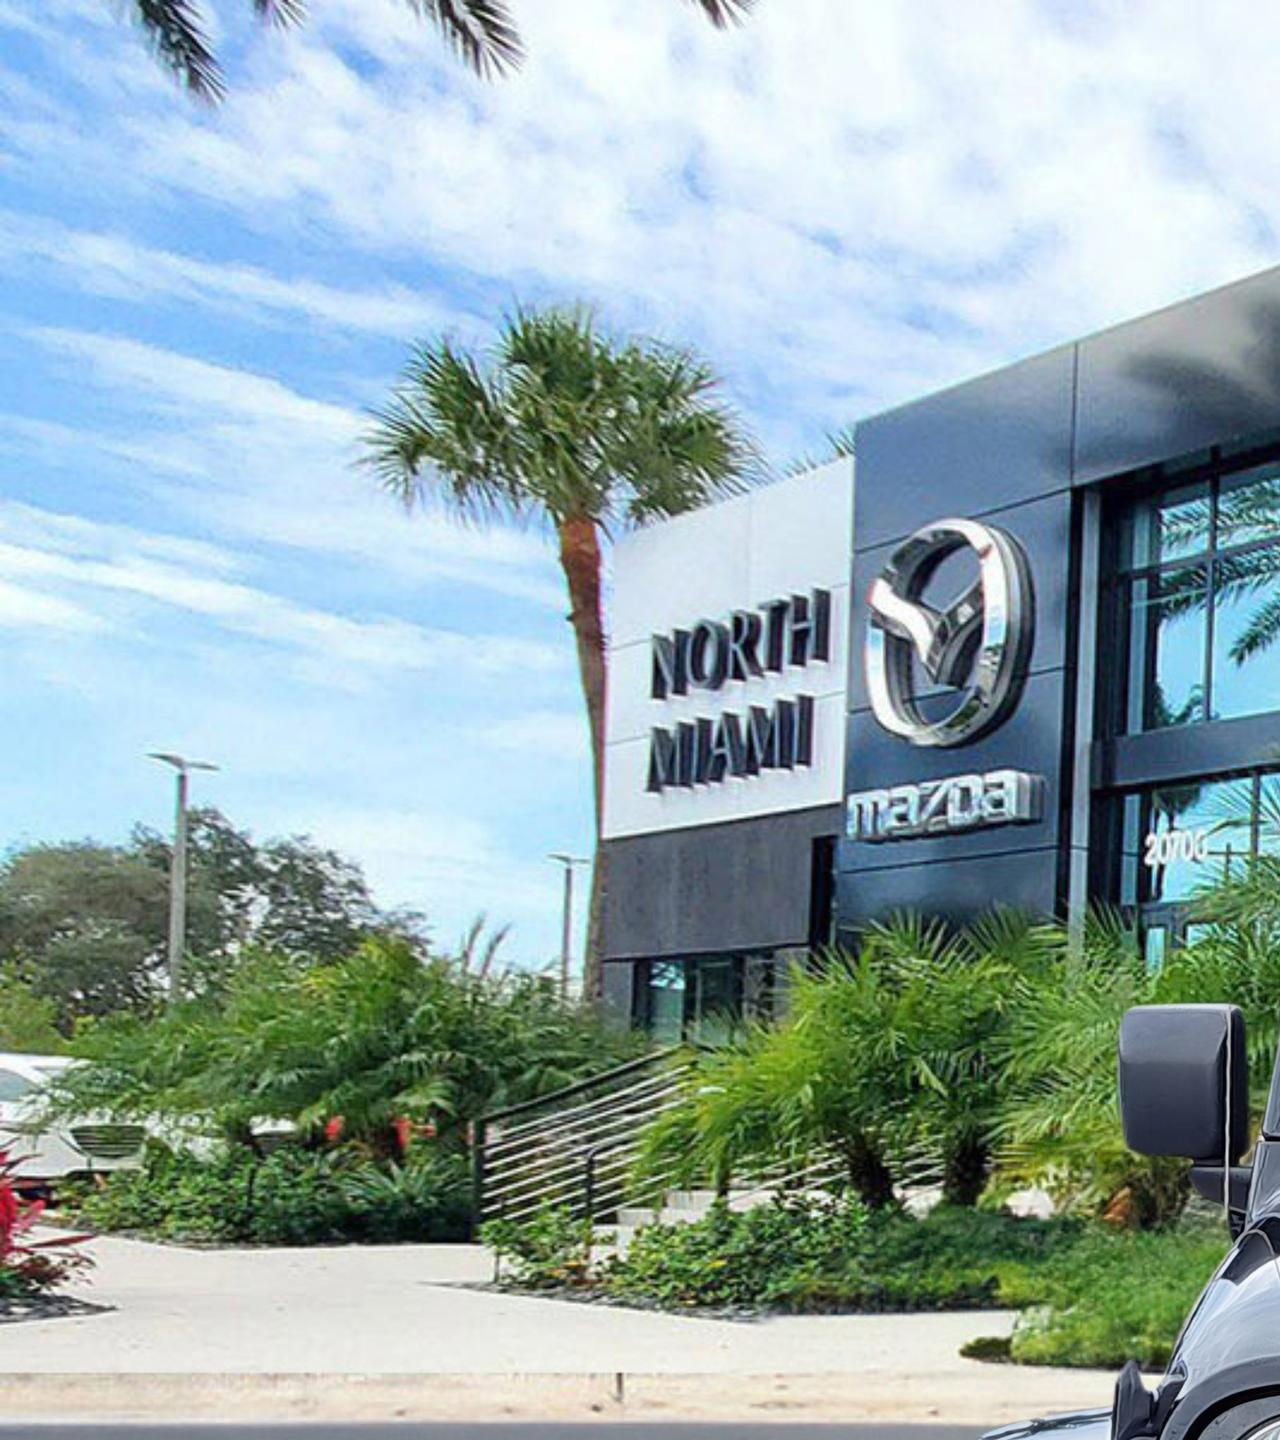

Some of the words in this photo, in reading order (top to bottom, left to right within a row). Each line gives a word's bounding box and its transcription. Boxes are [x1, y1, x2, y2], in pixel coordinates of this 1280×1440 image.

[651, 588, 831, 699] NORTH
[646, 694, 815, 792] MIAMI
[847, 769, 1044, 841] mazda
